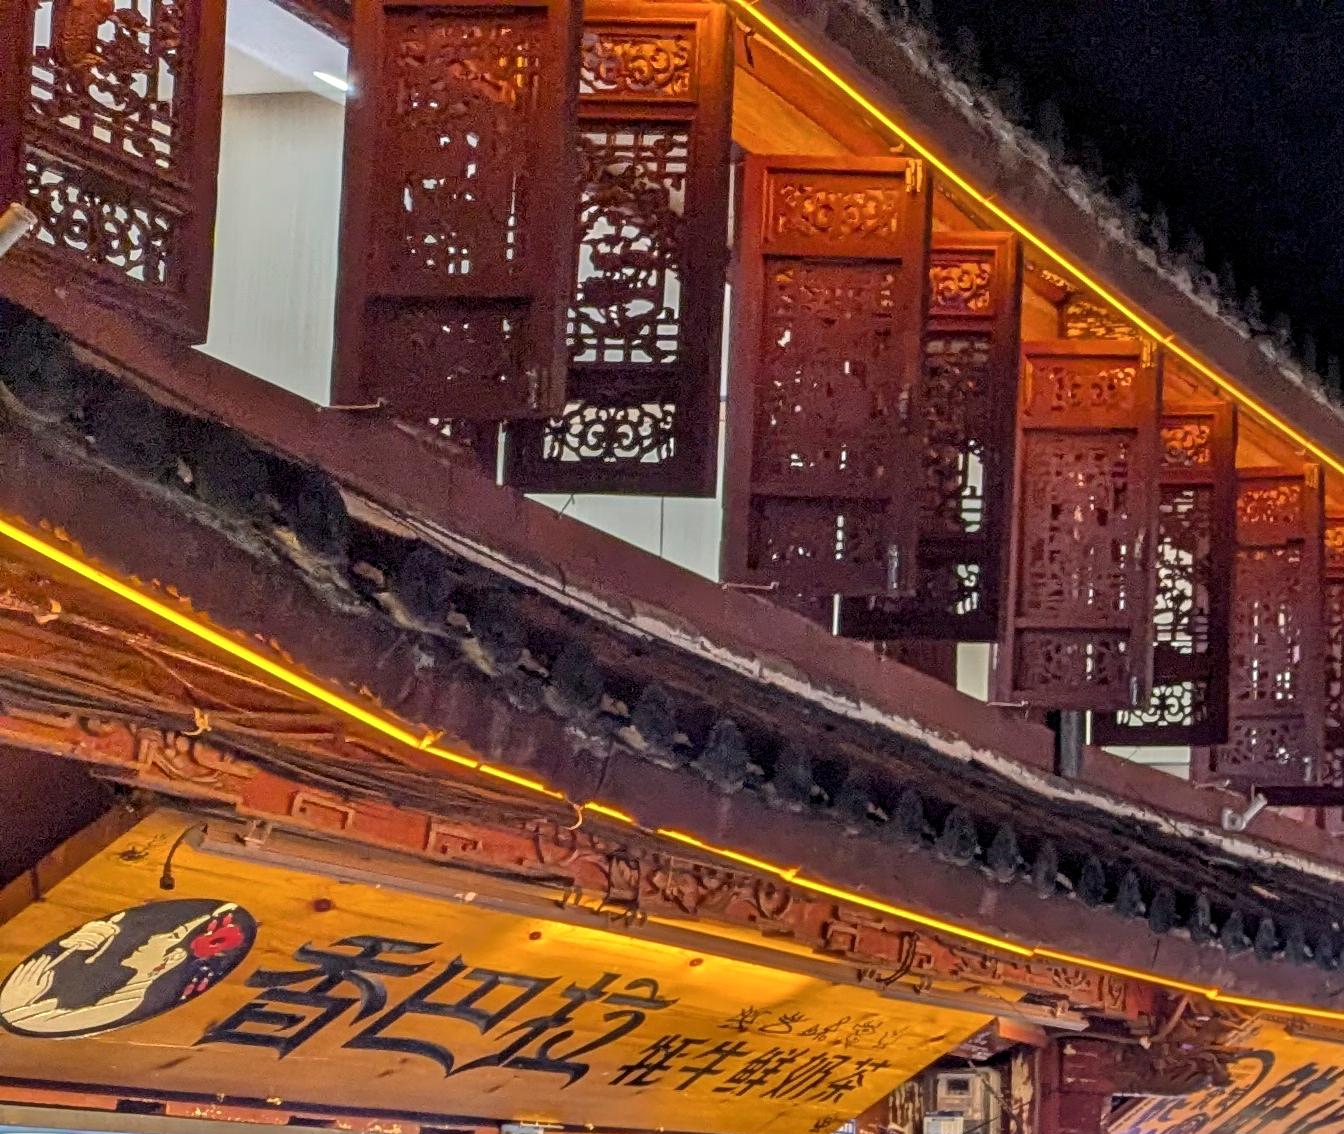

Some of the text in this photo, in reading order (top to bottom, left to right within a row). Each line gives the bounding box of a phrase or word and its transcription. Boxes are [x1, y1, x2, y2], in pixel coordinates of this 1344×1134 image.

[195, 933, 680, 1089] 香巴拉
[608, 1034, 892, 1104] 牦牛鲜奶茶
